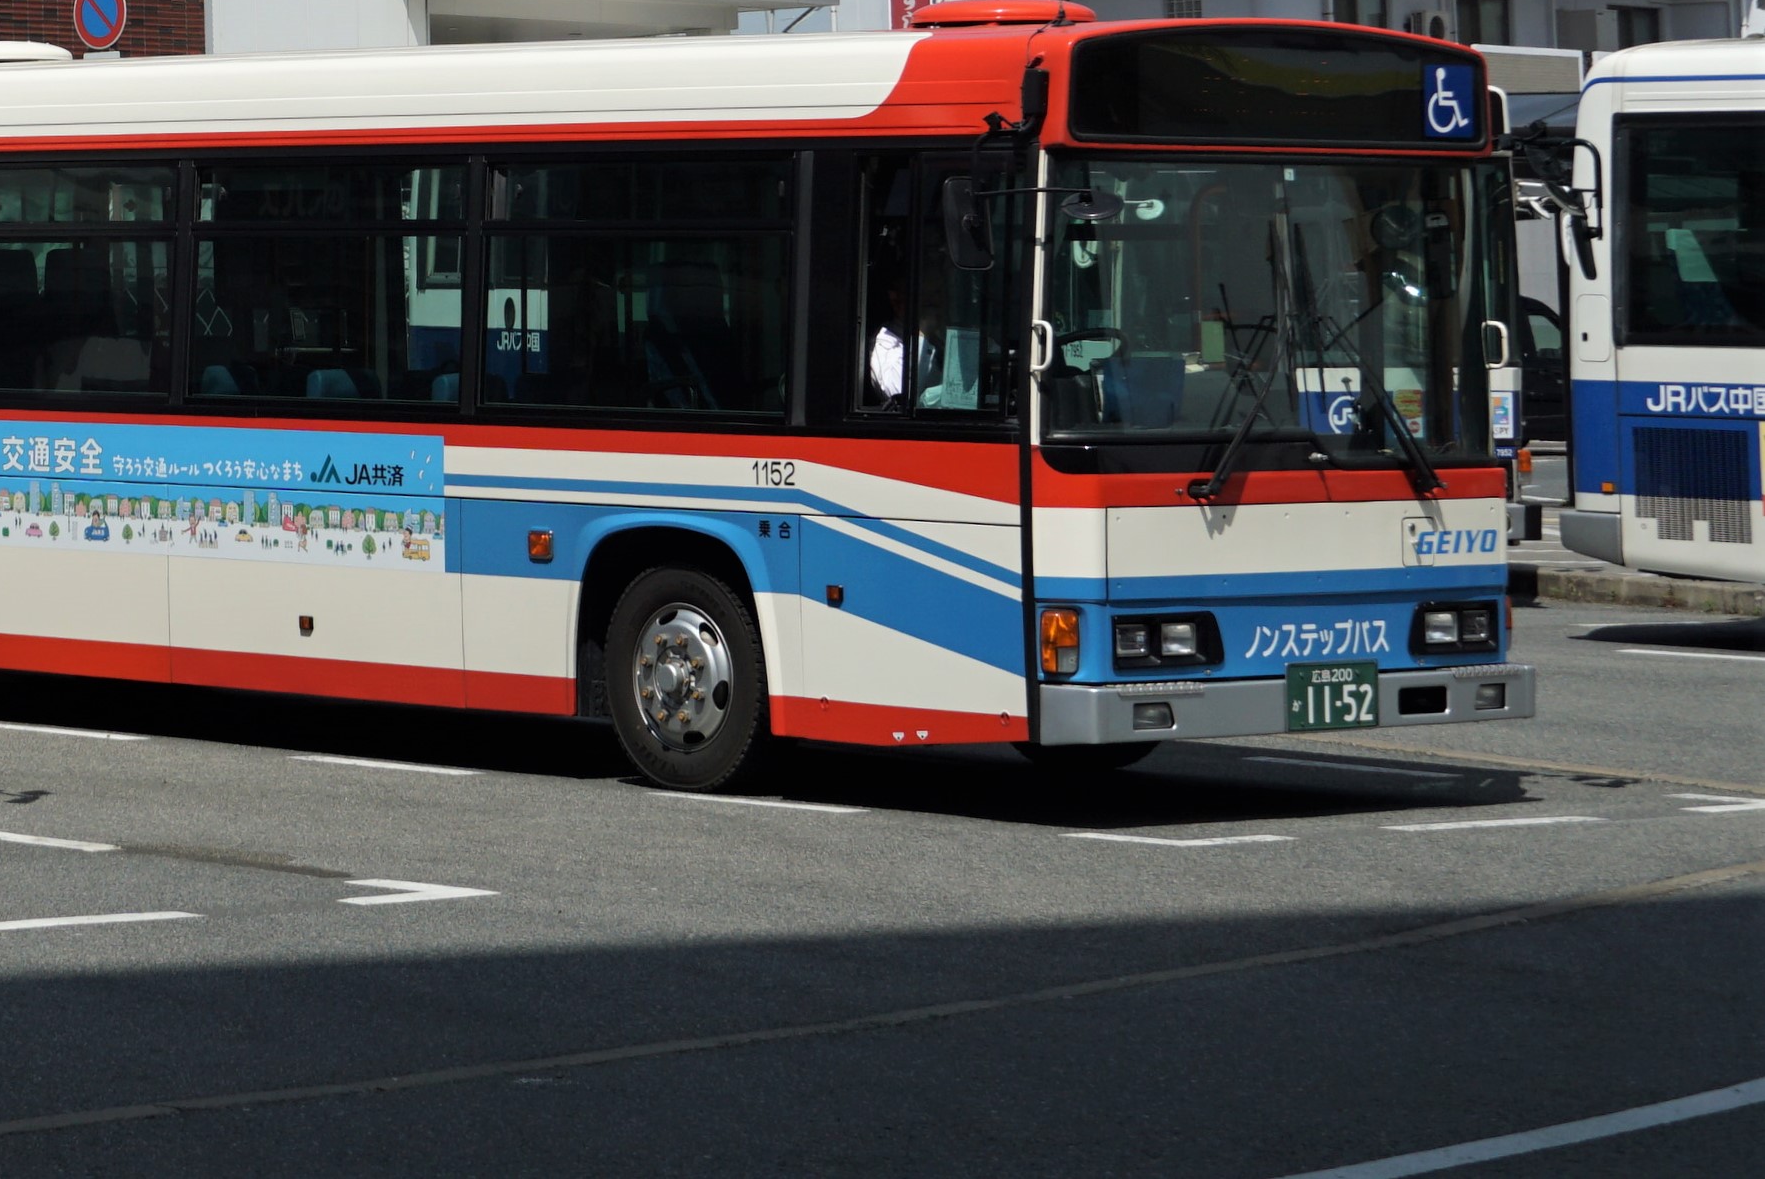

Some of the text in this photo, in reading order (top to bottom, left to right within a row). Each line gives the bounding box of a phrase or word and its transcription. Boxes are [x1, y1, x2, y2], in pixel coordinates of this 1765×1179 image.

[2, 435, 104, 475] 交通安全
[113, 454, 200, 478] 守ろう交通ルール
[752, 460, 797, 486] 1152
[345, 463, 405, 487] JA共済
[1417, 528, 1498, 555] GEIYO
[1244, 619, 1390, 659] ノンステップバス
[1307, 683, 1374, 725] 11-52
